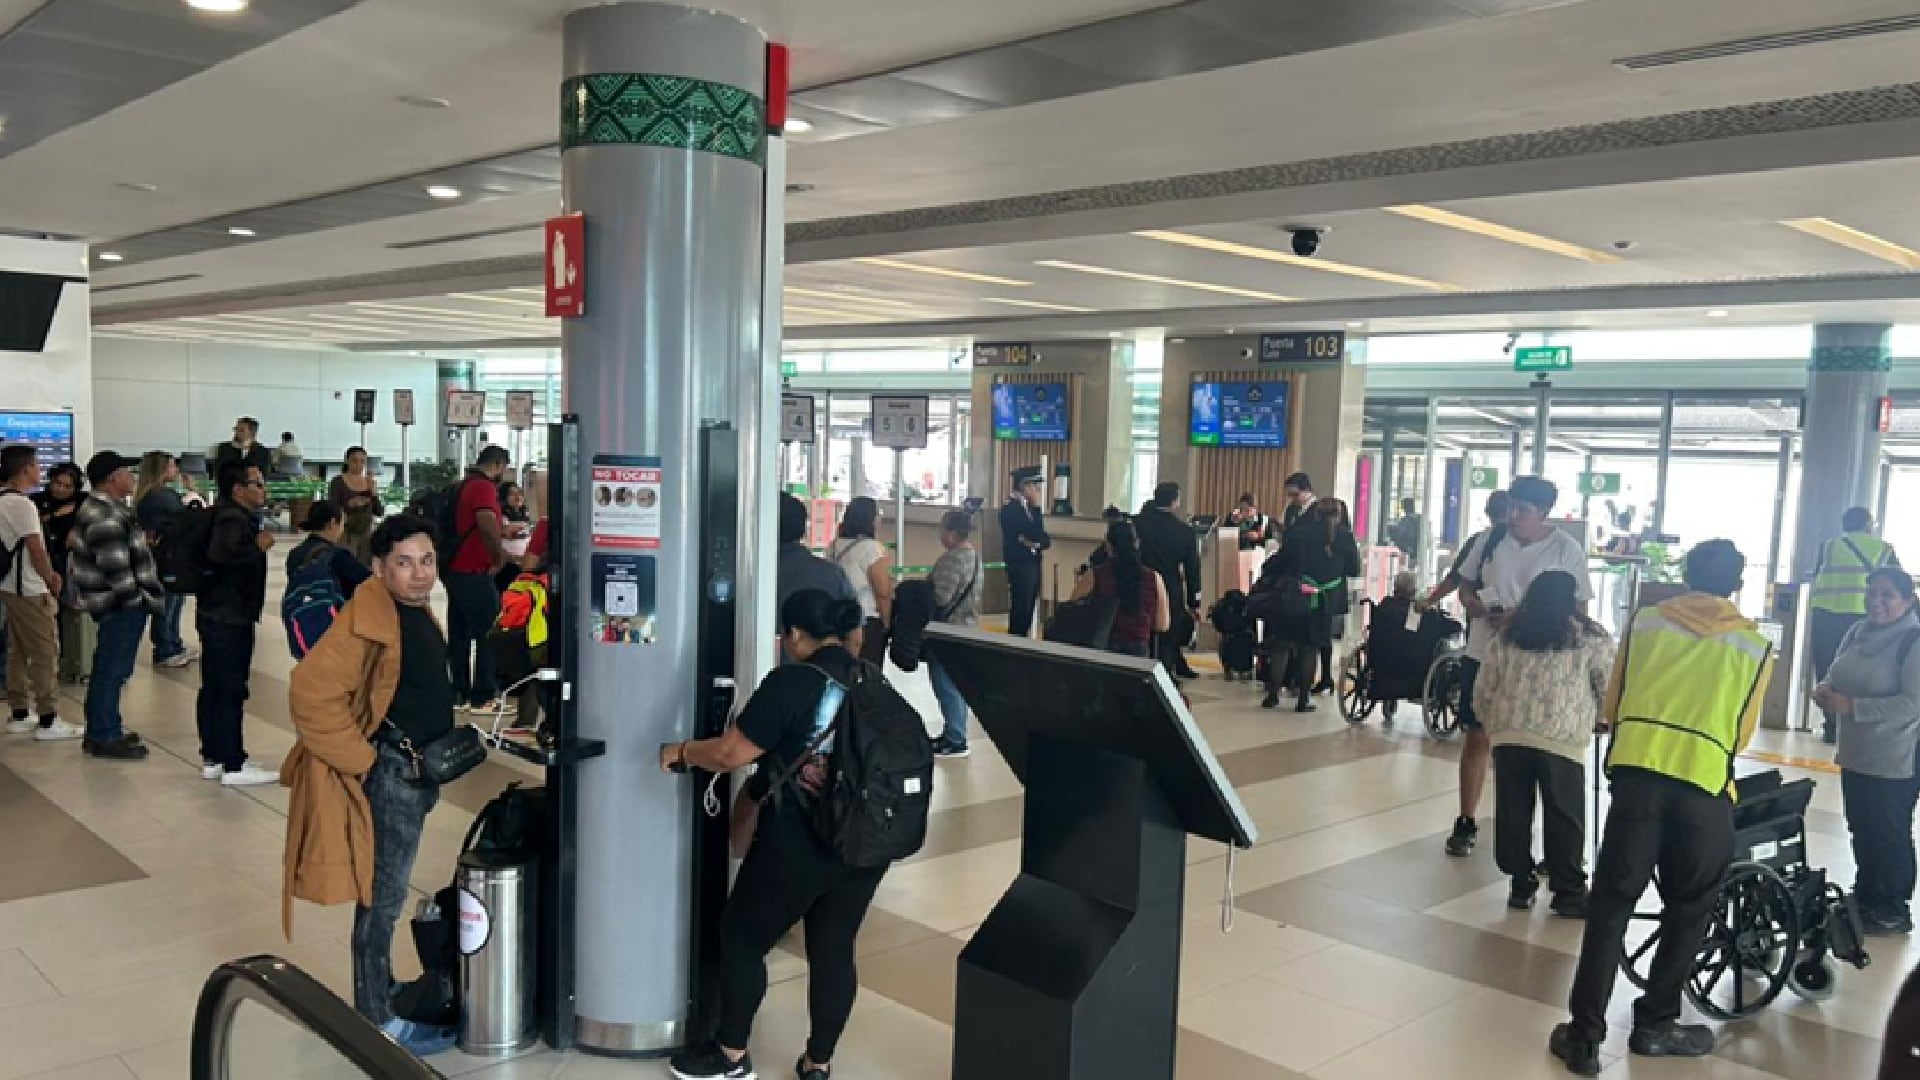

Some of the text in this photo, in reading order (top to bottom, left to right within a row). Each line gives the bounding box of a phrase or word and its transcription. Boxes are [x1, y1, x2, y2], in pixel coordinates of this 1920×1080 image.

[1004, 345, 1027, 363] 104
[1263, 336, 1338, 358] Puerta 103
[7, 417, 70, 430] Departures
[594, 470, 612, 480] NO
